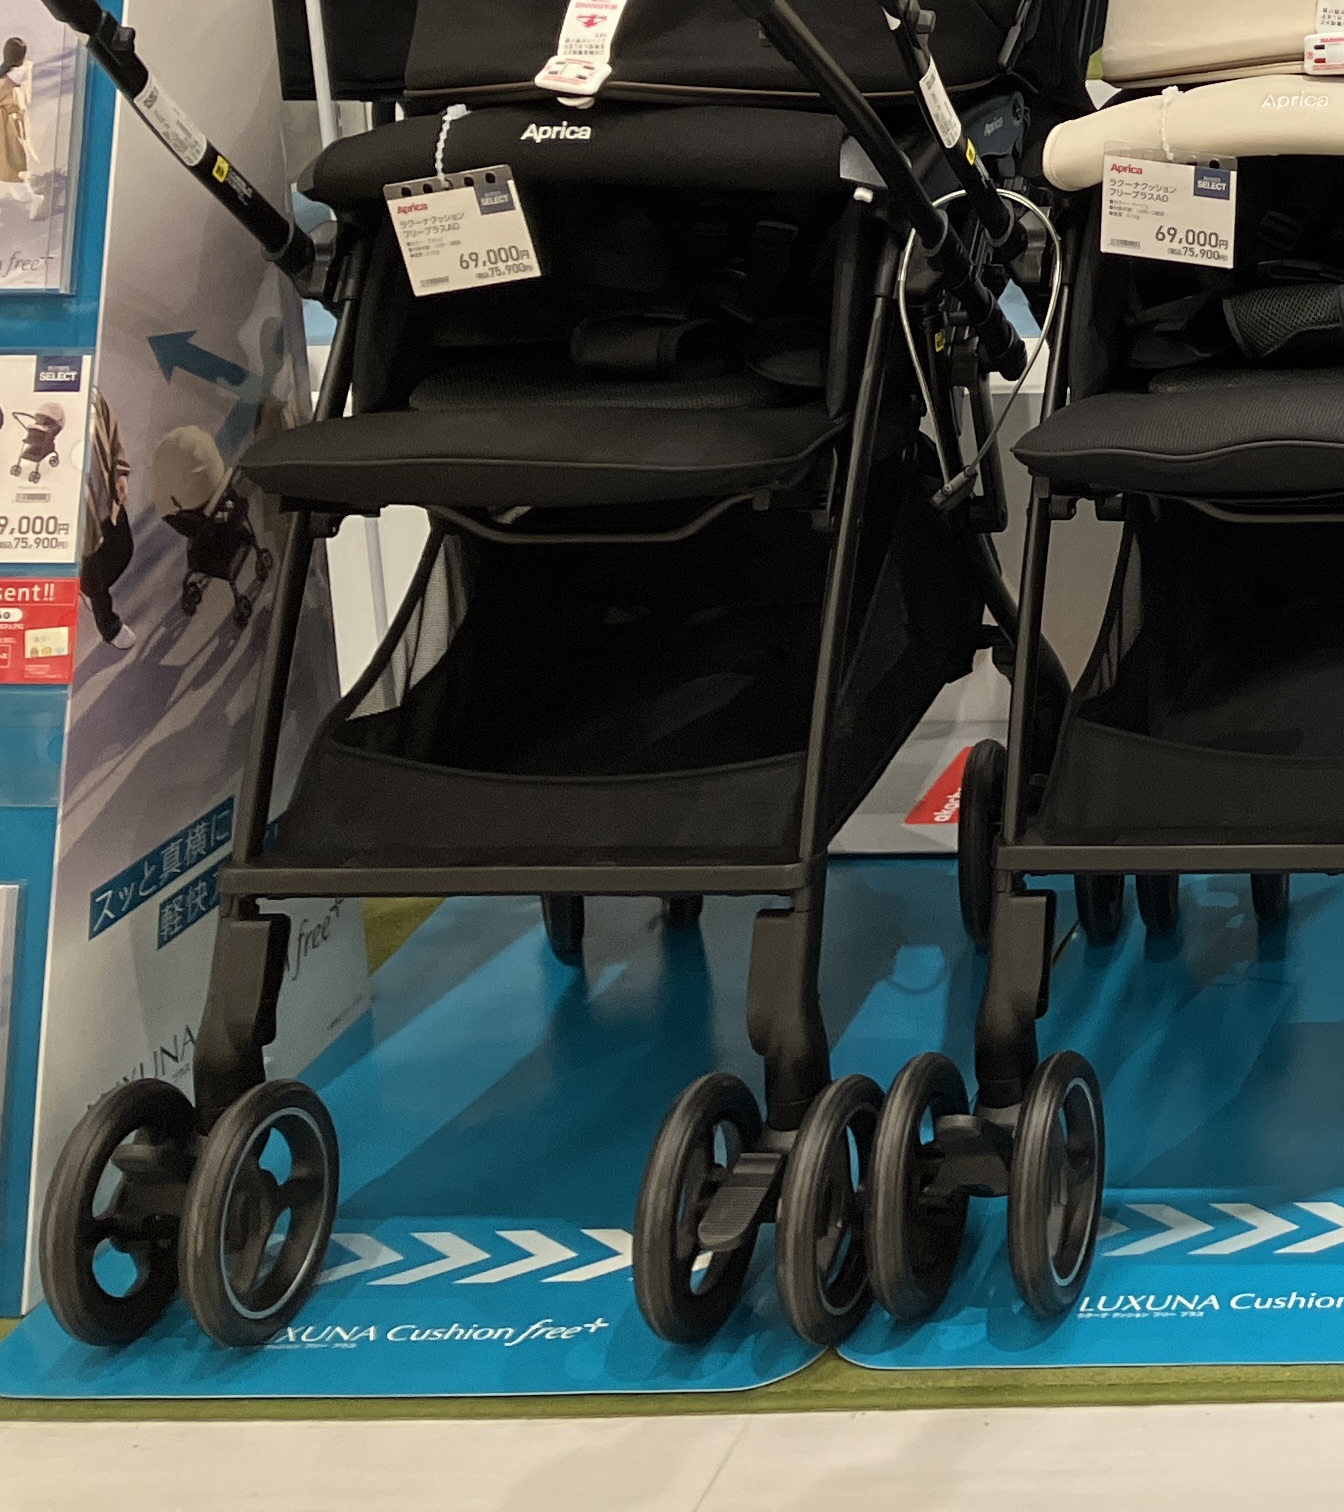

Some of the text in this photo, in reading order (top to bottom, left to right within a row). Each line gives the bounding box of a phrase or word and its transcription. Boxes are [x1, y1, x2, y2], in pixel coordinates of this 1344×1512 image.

[1261, 91, 1328, 110] Aprica
[520, 121, 592, 143] Aprica
[1110, 162, 1143, 175] Aprica
[1108, 178, 1176, 194] ラクーナクッション
[1197, 180, 1227, 191] SELECT
[480, 194, 508, 206] SELECT
[1108, 189, 1169, 203] フリープラスAD
[396, 201, 428, 215] Aprica
[1155, 225, 1228, 250] 69,000円
[459, 245, 530, 270] 69,000円
[39, 371, 77, 382] SELECT
[94, 808, 231, 931] スッと真横に
[1080, 1294, 1220, 1312] LUXUNA
[386, 1324, 514, 1341] Cushion
